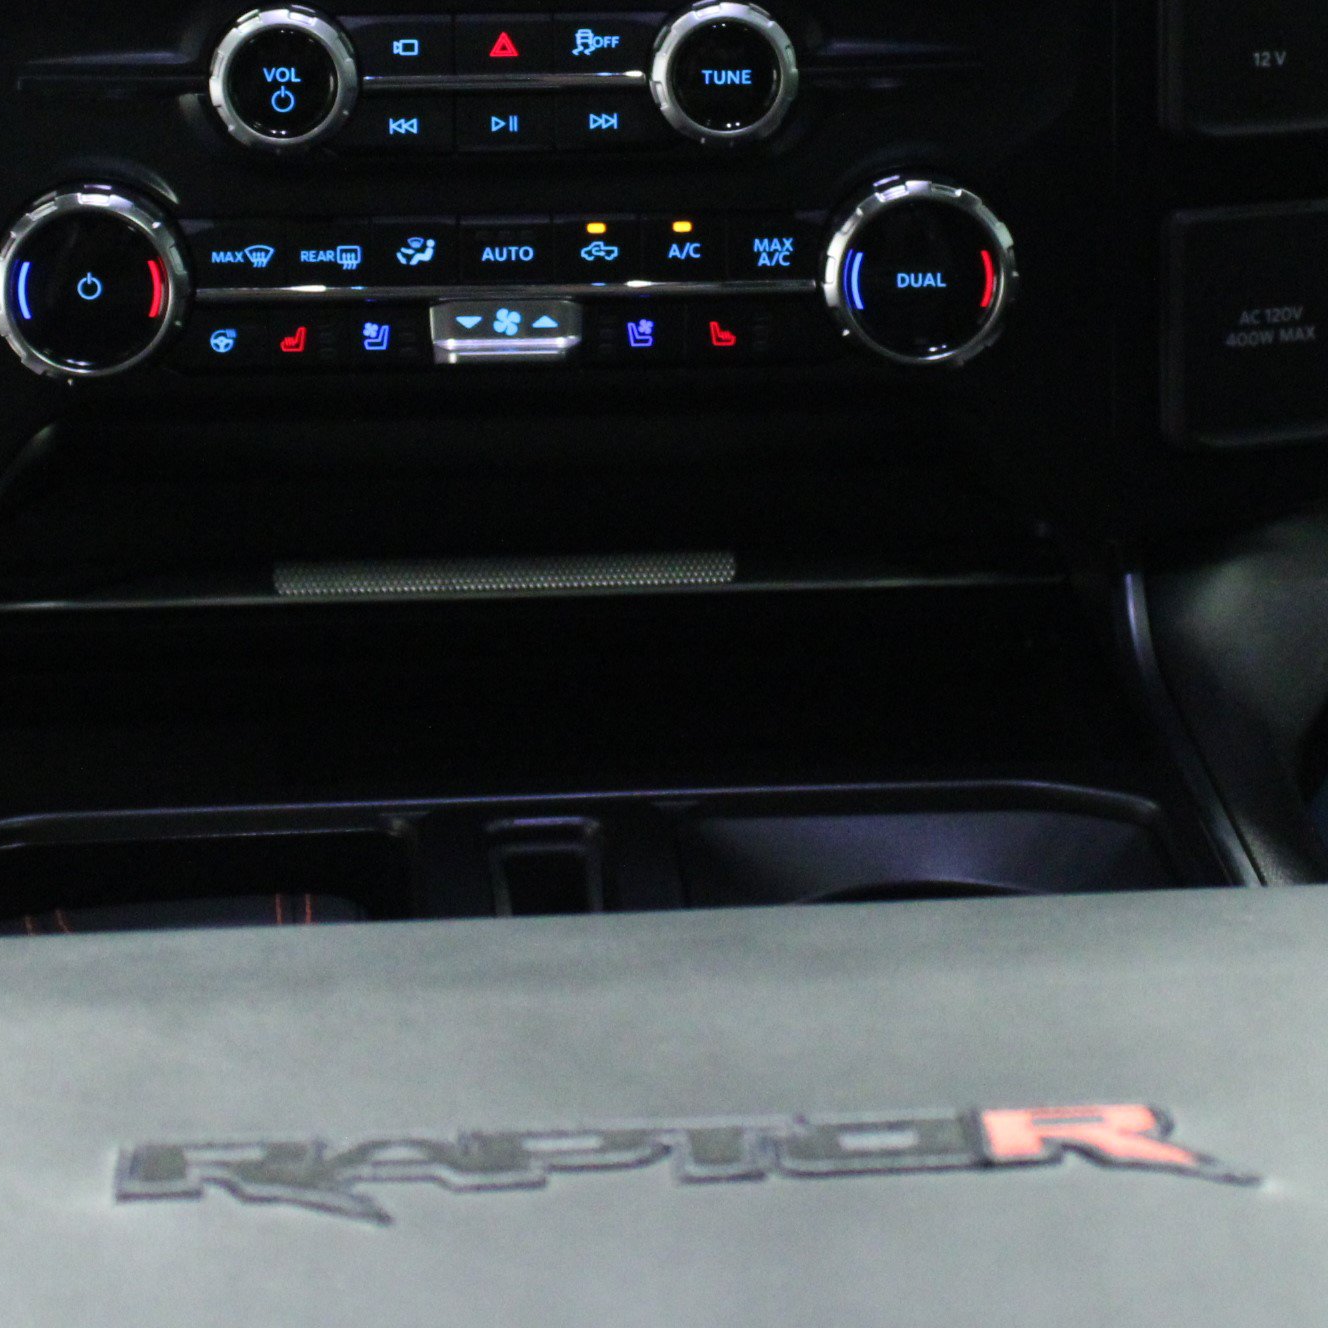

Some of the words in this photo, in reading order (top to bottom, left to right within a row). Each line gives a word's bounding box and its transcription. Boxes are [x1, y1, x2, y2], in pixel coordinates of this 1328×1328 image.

[594, 36, 620, 49] OFF
[1253, 52, 1272, 67] 12
[264, 68, 301, 83] VOL
[702, 70, 752, 85] TUNE
[668, 243, 701, 260] A/C
[753, 238, 794, 253] MAX
[211, 252, 244, 263] MAX
[300, 251, 335, 263] REAR
[482, 247, 534, 262] AUTO
[758, 251, 790, 267] A/C
[896, 273, 947, 288] DUAL
[112, 1102, 1264, 1227] RAPTOR
